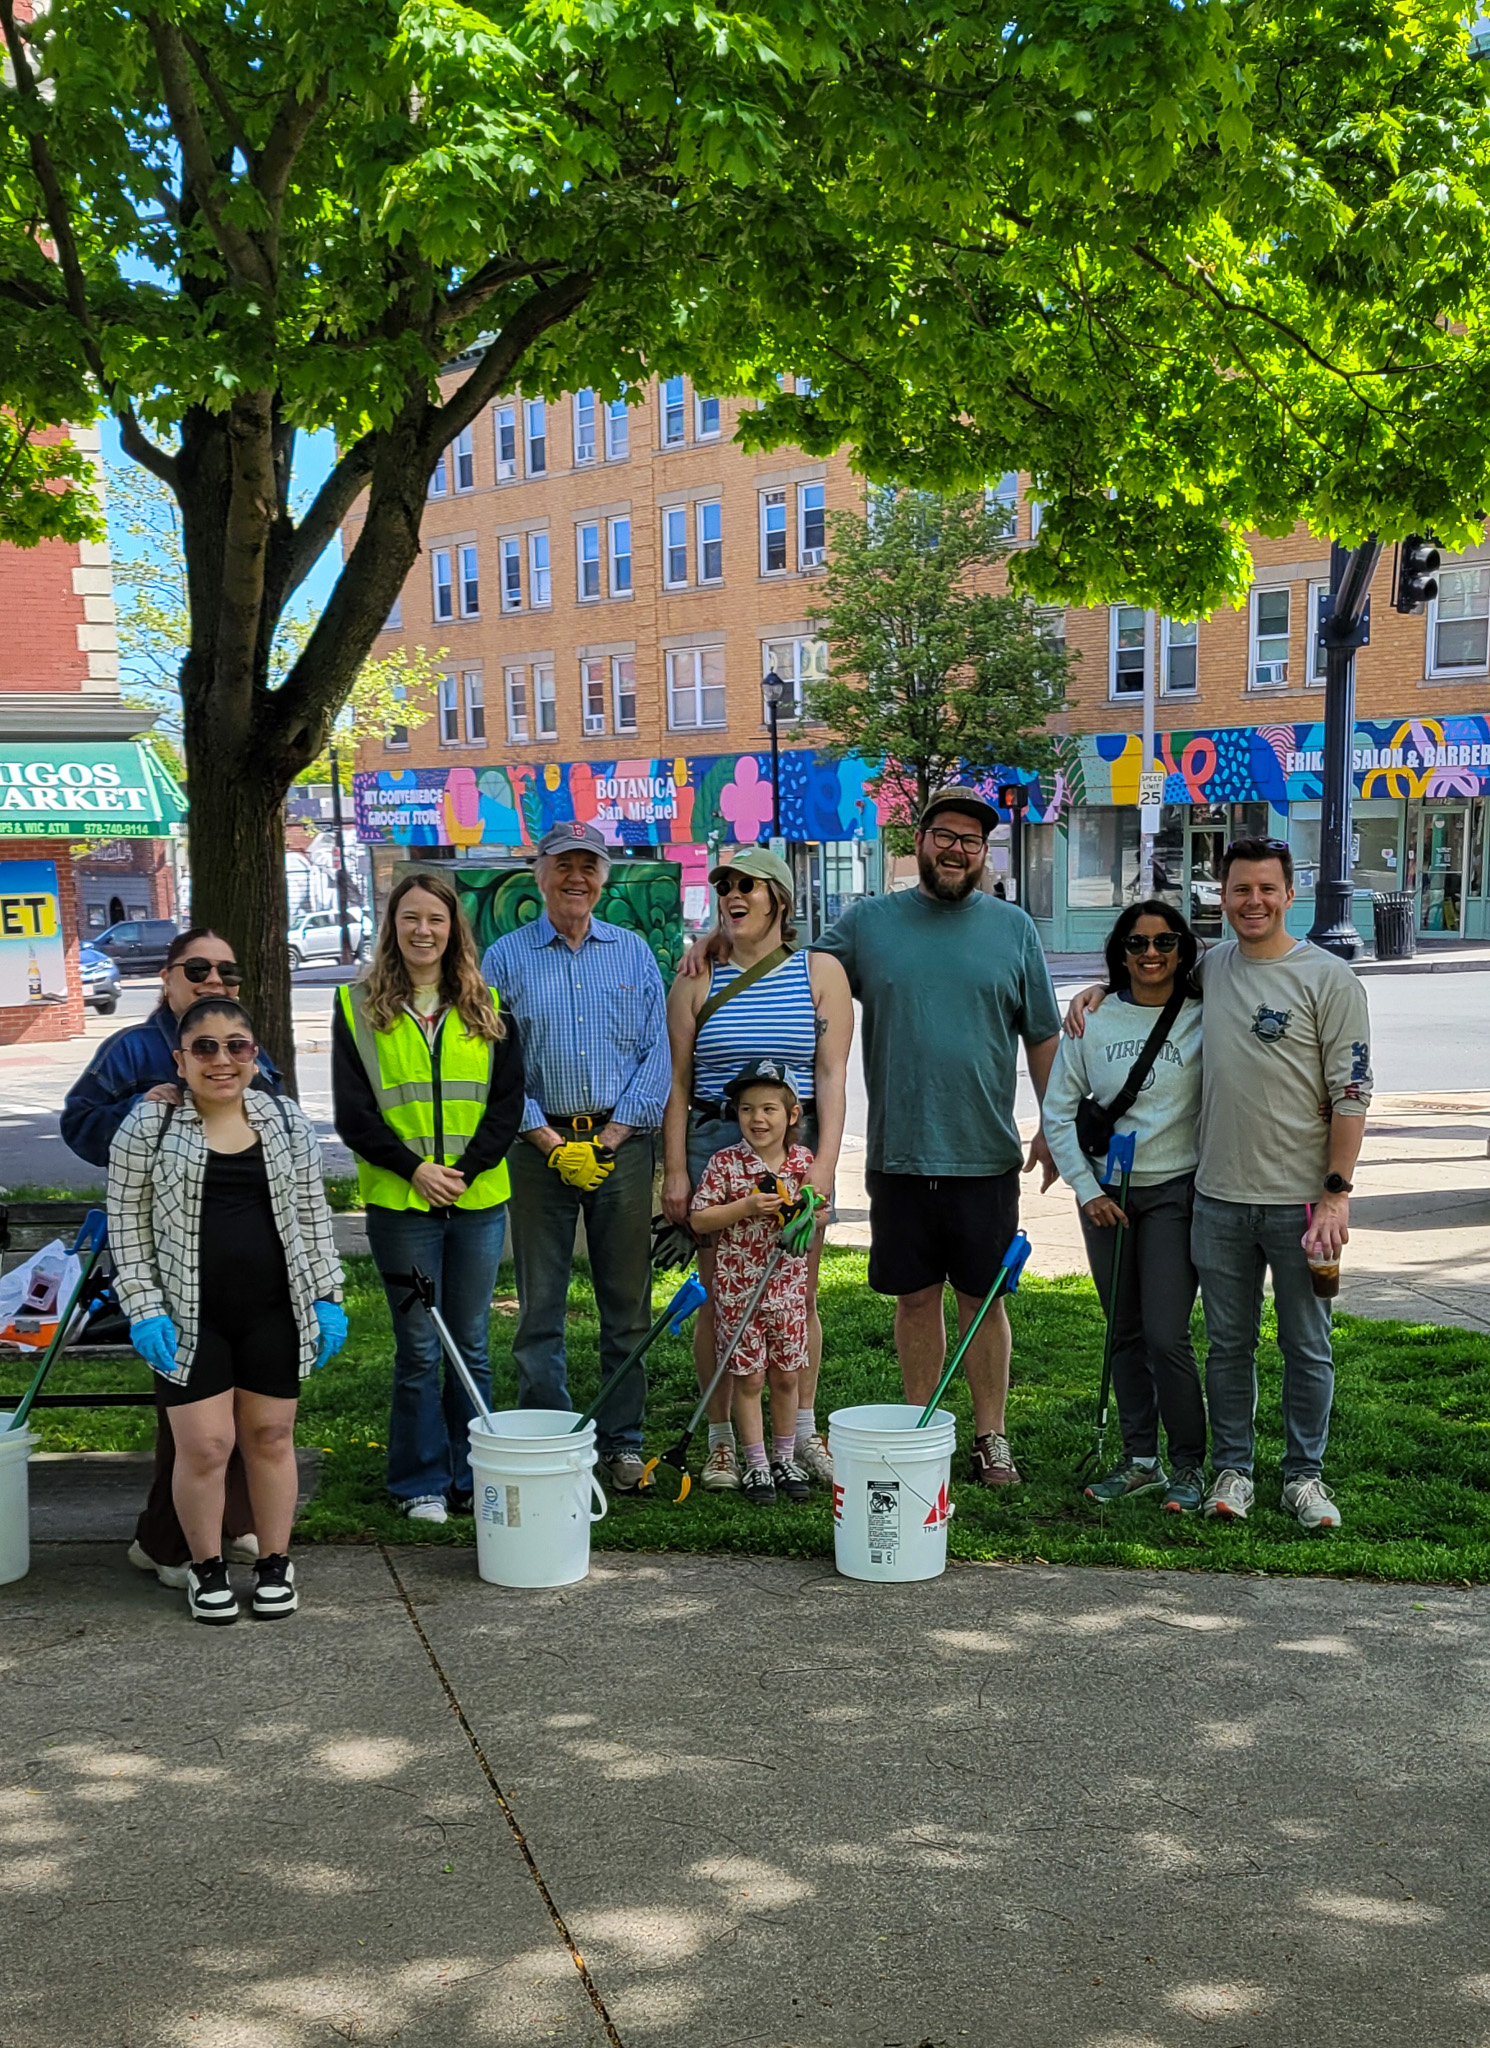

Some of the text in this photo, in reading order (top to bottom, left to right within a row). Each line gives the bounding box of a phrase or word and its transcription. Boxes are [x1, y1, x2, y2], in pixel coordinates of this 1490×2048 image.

[1286, 751, 1324, 772] ERIK
[1352, 748, 1403, 770] SALON
[1406, 750, 1419, 768] &
[379, 788, 443, 804] CONVENIENCE
[596, 776, 677, 799] BOTANICA
[1140, 791, 1161, 805] 25
[368, 810, 441, 826] GROCERY STORE
[597, 800, 678, 824] San Miguel
[23, 822, 45, 833] WIC
[48, 822, 70, 834] ATM
[1105, 1039, 1184, 1068] VIRGIA
